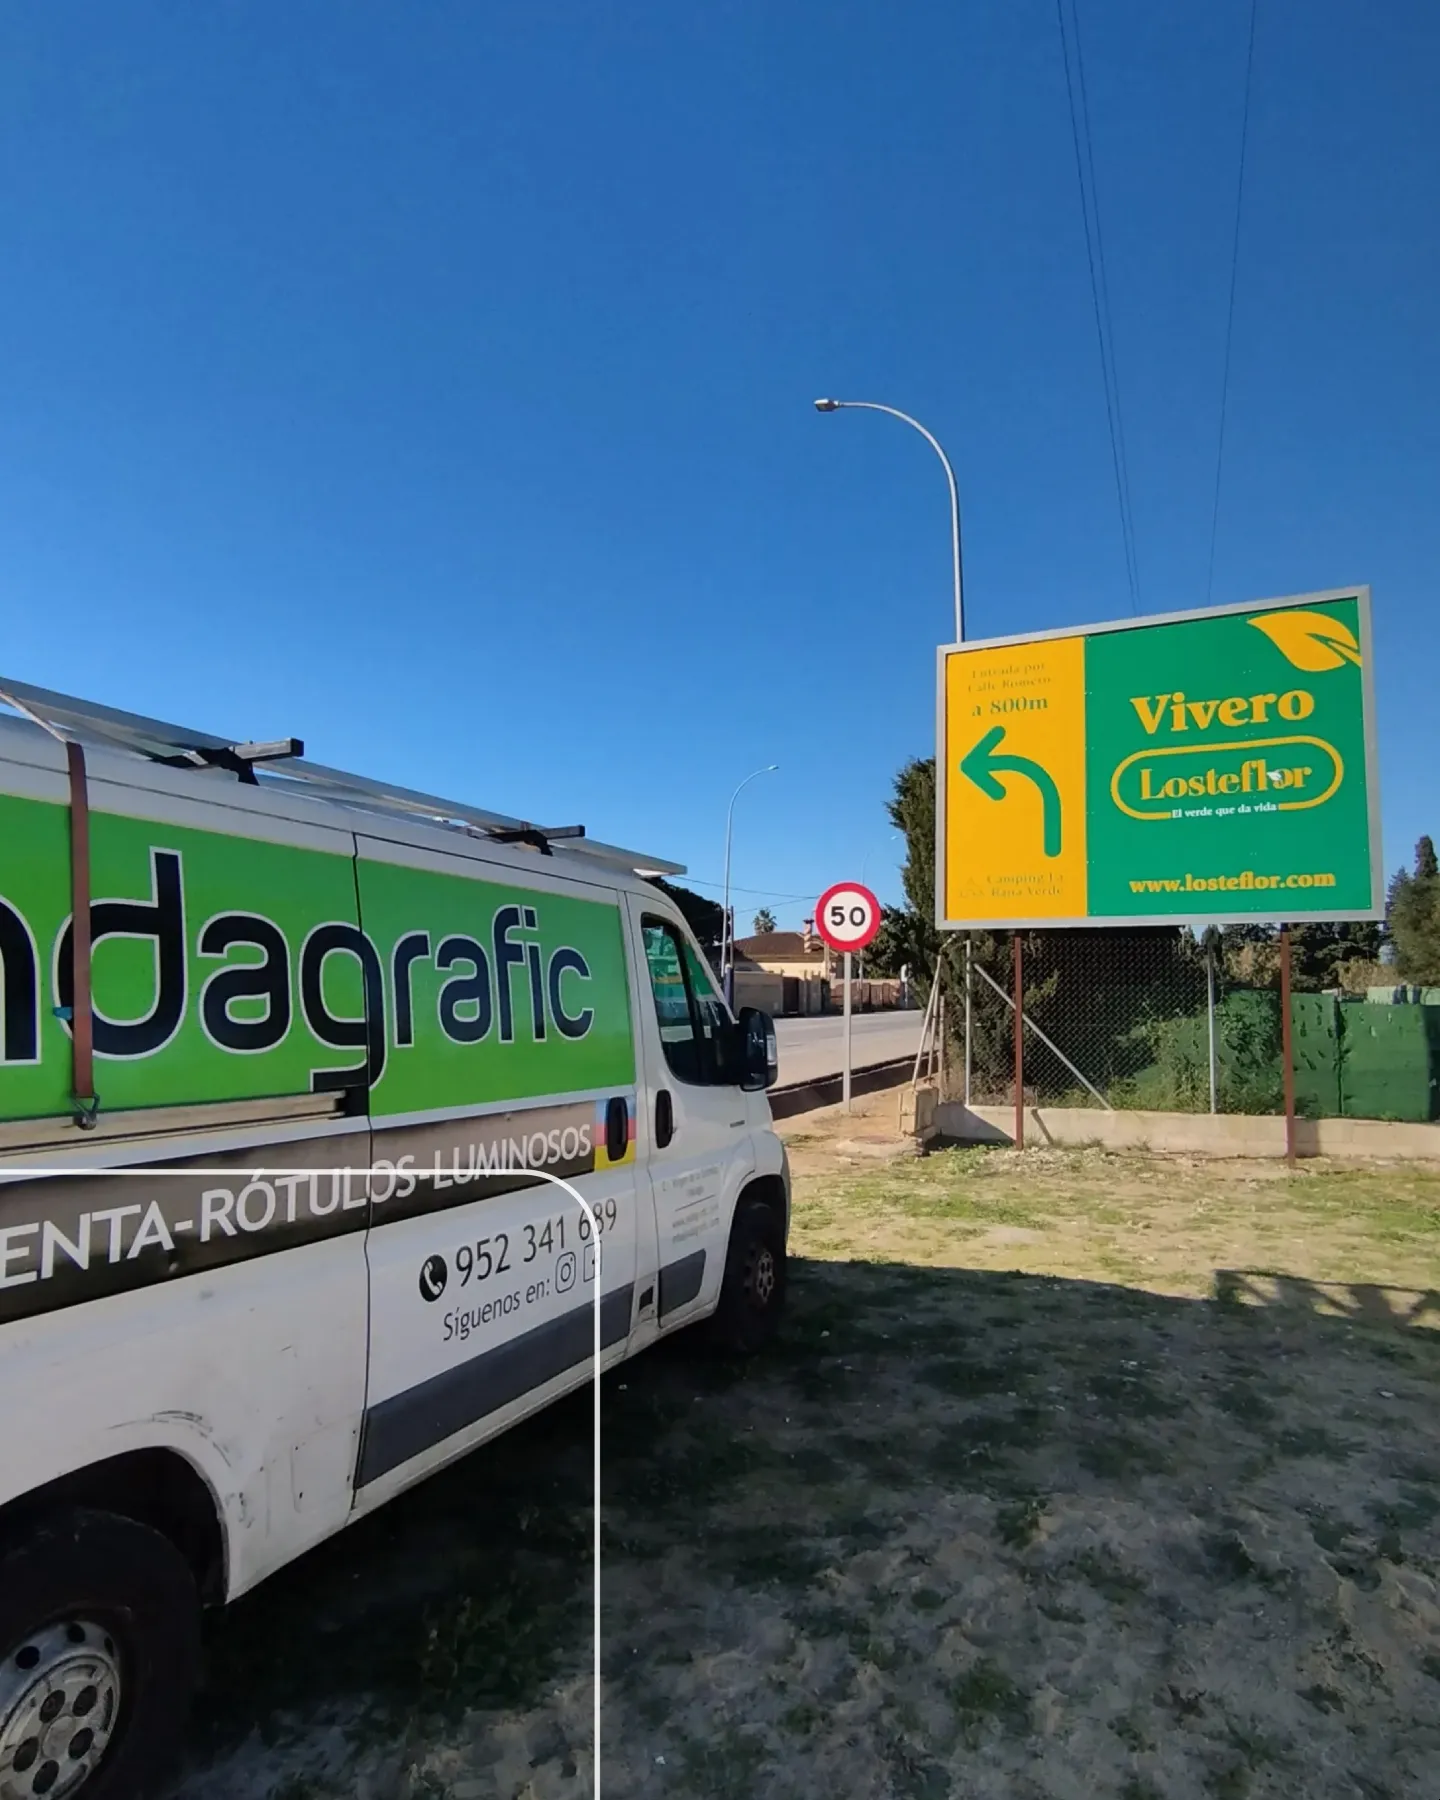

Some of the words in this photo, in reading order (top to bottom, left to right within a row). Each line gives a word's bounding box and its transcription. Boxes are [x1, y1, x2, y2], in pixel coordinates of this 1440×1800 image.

[972, 705, 982, 717] a
[990, 696, 1048, 714] 800m
[1130, 690, 1314, 734] Vivero
[1140, 759, 1312, 800] Losteflor
[1172, 809, 1182, 818] El
[1185, 806, 1212, 817] verde
[1215, 806, 1235, 817] que
[1238, 803, 1251, 814] da
[1254, 802, 1277, 812] vida
[1129, 871, 1336, 893] www.losteflor.com
[830, 906, 866, 927] 50
[456, 1233, 511, 1287] 952
[523, 1215, 565, 1262] 341
[578, 1198, 617, 1241] 689
[443, 1290, 520, 1341] Síguenos
[526, 1278, 550, 1304] en:
